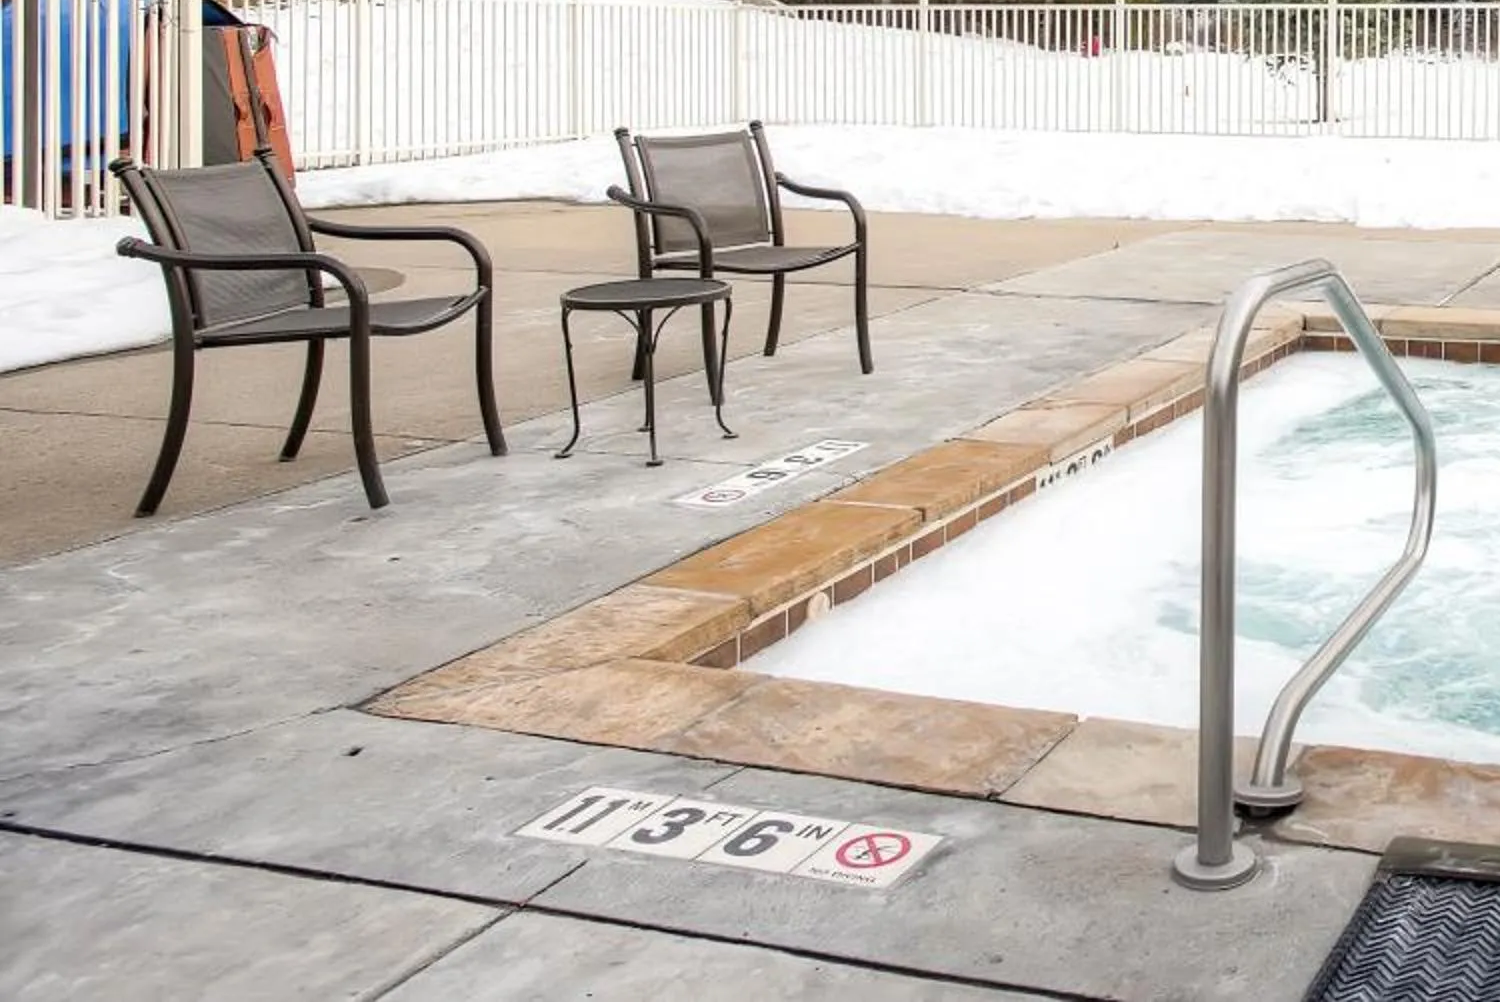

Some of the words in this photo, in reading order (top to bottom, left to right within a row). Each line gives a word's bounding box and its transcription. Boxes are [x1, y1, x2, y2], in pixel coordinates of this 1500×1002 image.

[627, 800, 653, 812] M
[631, 807, 706, 844] 3
[703, 811, 743, 827] FT
[723, 819, 794, 857] 6
[795, 823, 833, 841] IN
